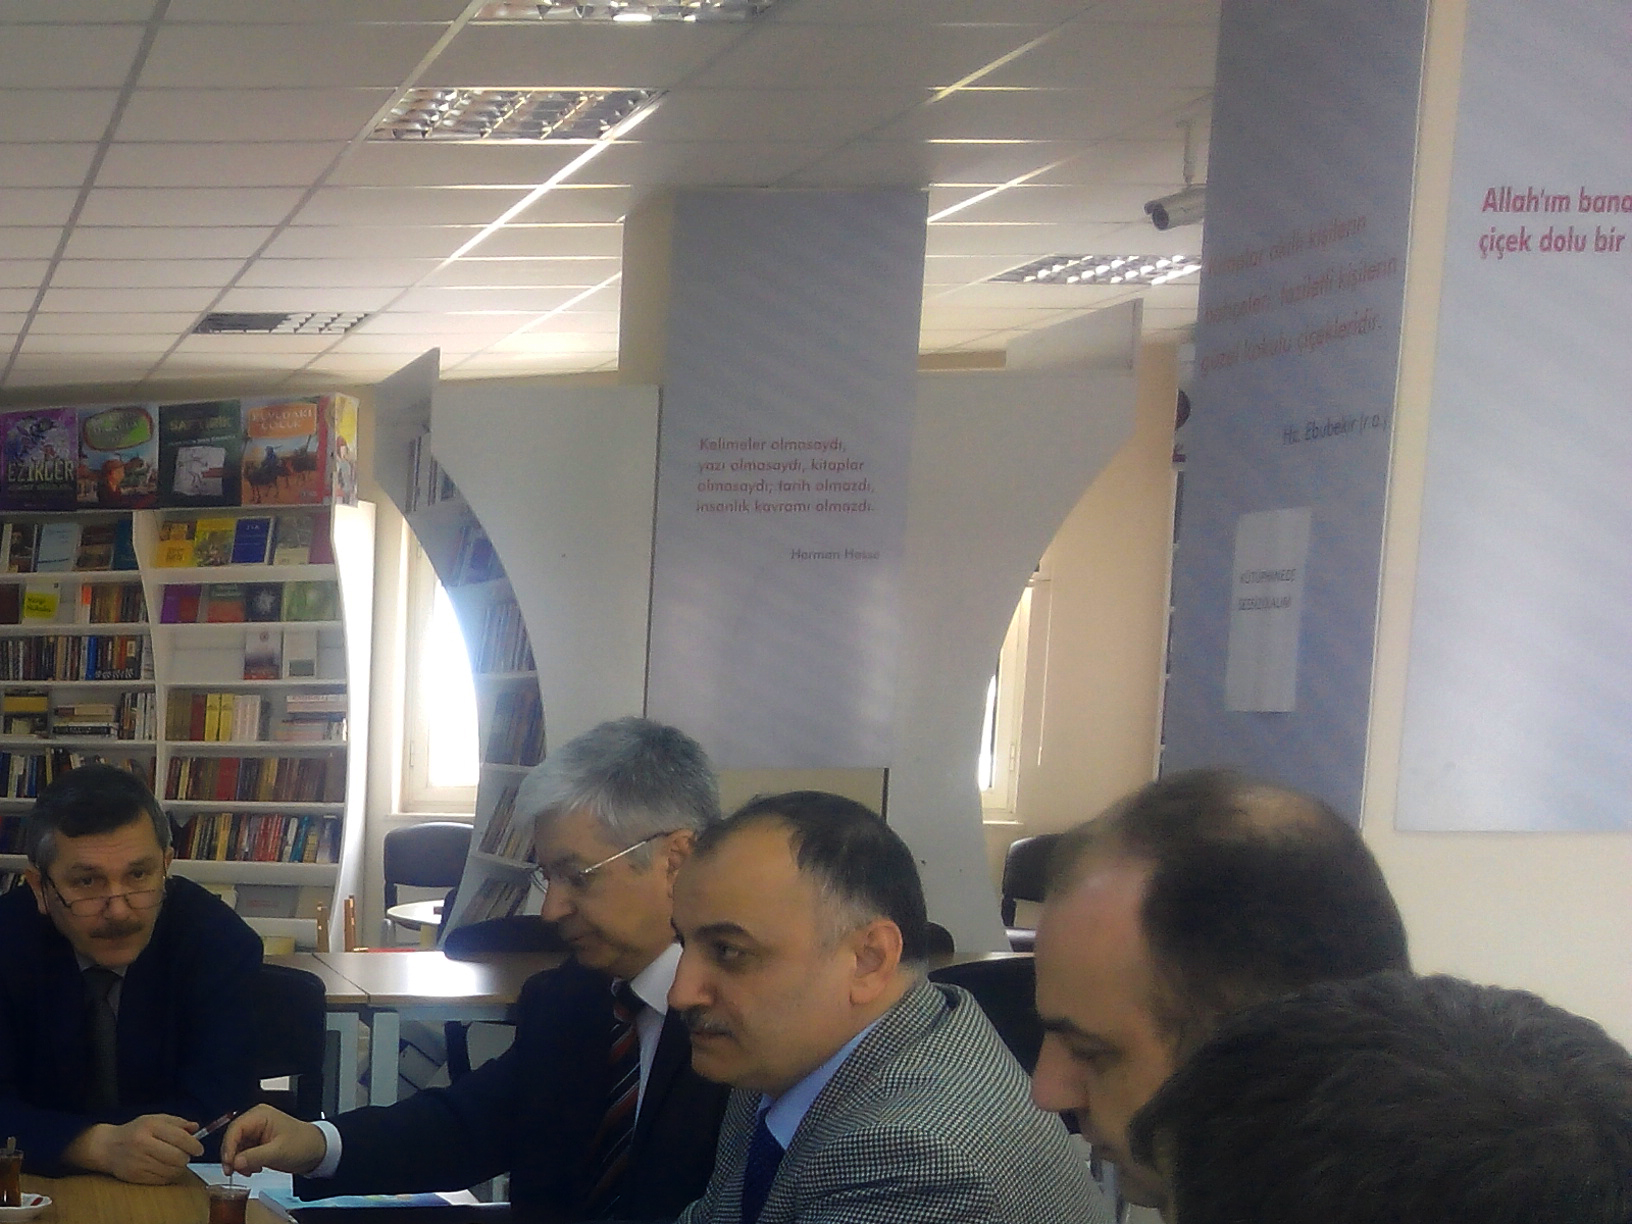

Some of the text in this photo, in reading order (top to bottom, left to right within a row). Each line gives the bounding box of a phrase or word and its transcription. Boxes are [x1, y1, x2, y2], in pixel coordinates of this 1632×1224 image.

[1481, 187, 1570, 213] Allah'ım
[1479, 225, 1625, 260] çiçek dolu bir
[699, 437, 847, 453] Kelimeler olmasaydı,
[698, 458, 864, 474] yazı olmasaydı, kitaplar
[778, 480, 811, 492] tarih
[754, 501, 811, 513] kavramı
[790, 549, 841, 561] Herman
